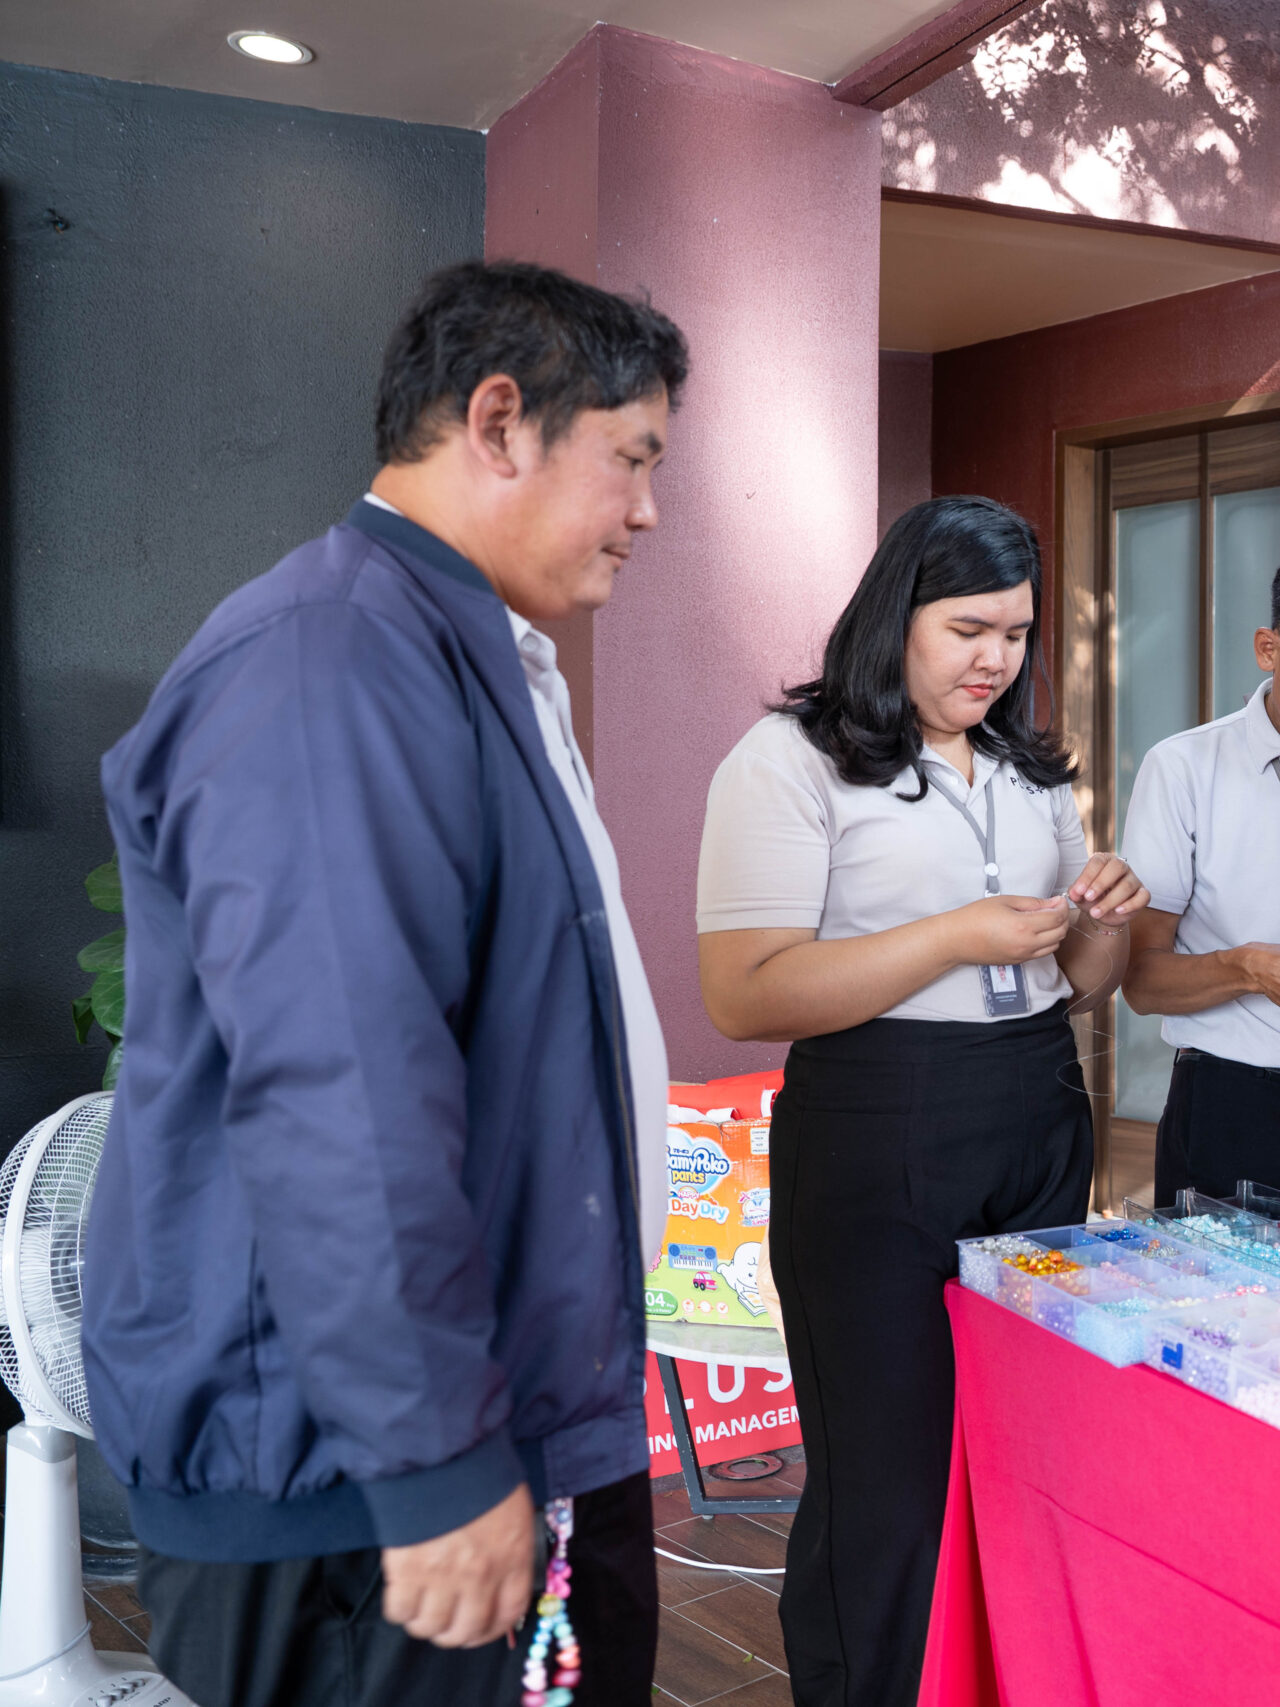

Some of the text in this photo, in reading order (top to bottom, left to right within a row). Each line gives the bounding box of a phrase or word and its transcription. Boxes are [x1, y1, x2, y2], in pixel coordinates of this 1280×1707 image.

[671, 1170, 707, 1184] pants
[671, 1198, 699, 1216] Day
[700, 1201, 727, 1220] Dry
